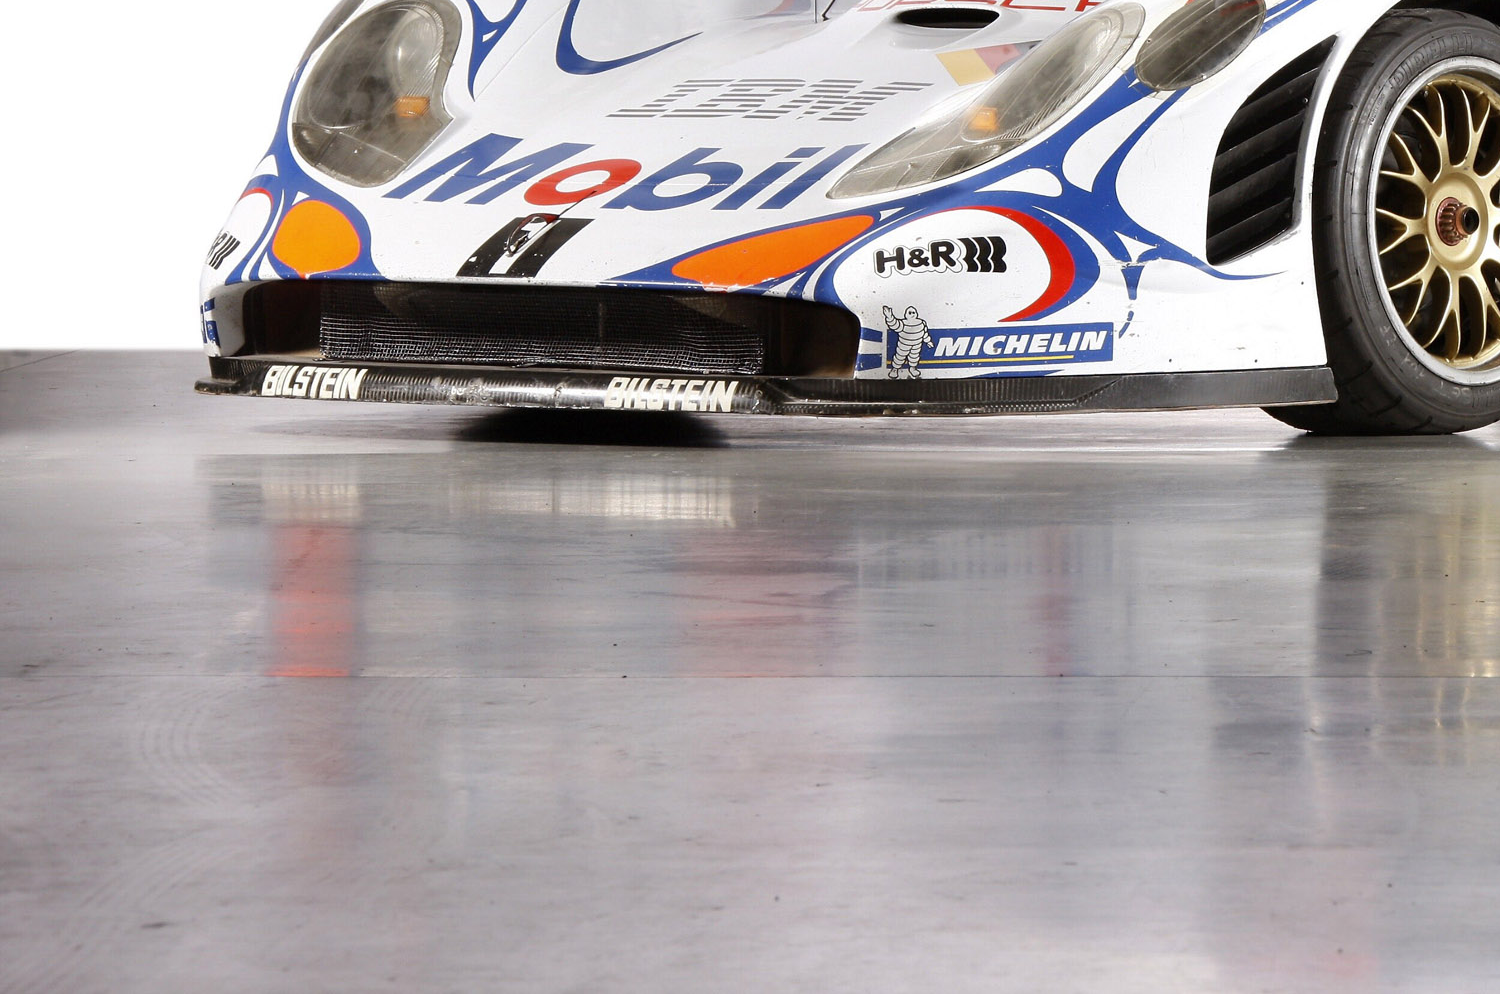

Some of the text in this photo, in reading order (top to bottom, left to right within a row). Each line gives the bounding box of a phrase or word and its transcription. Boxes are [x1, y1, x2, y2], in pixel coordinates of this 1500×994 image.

[605, 78, 935, 122] IBM
[382, 132, 870, 212] Mobil
[875, 239, 958, 275] H&R
[933, 330, 1108, 357] MICHELIN
[261, 364, 369, 400] BILSTEIN
[603, 377, 739, 413] BILSTEIN
